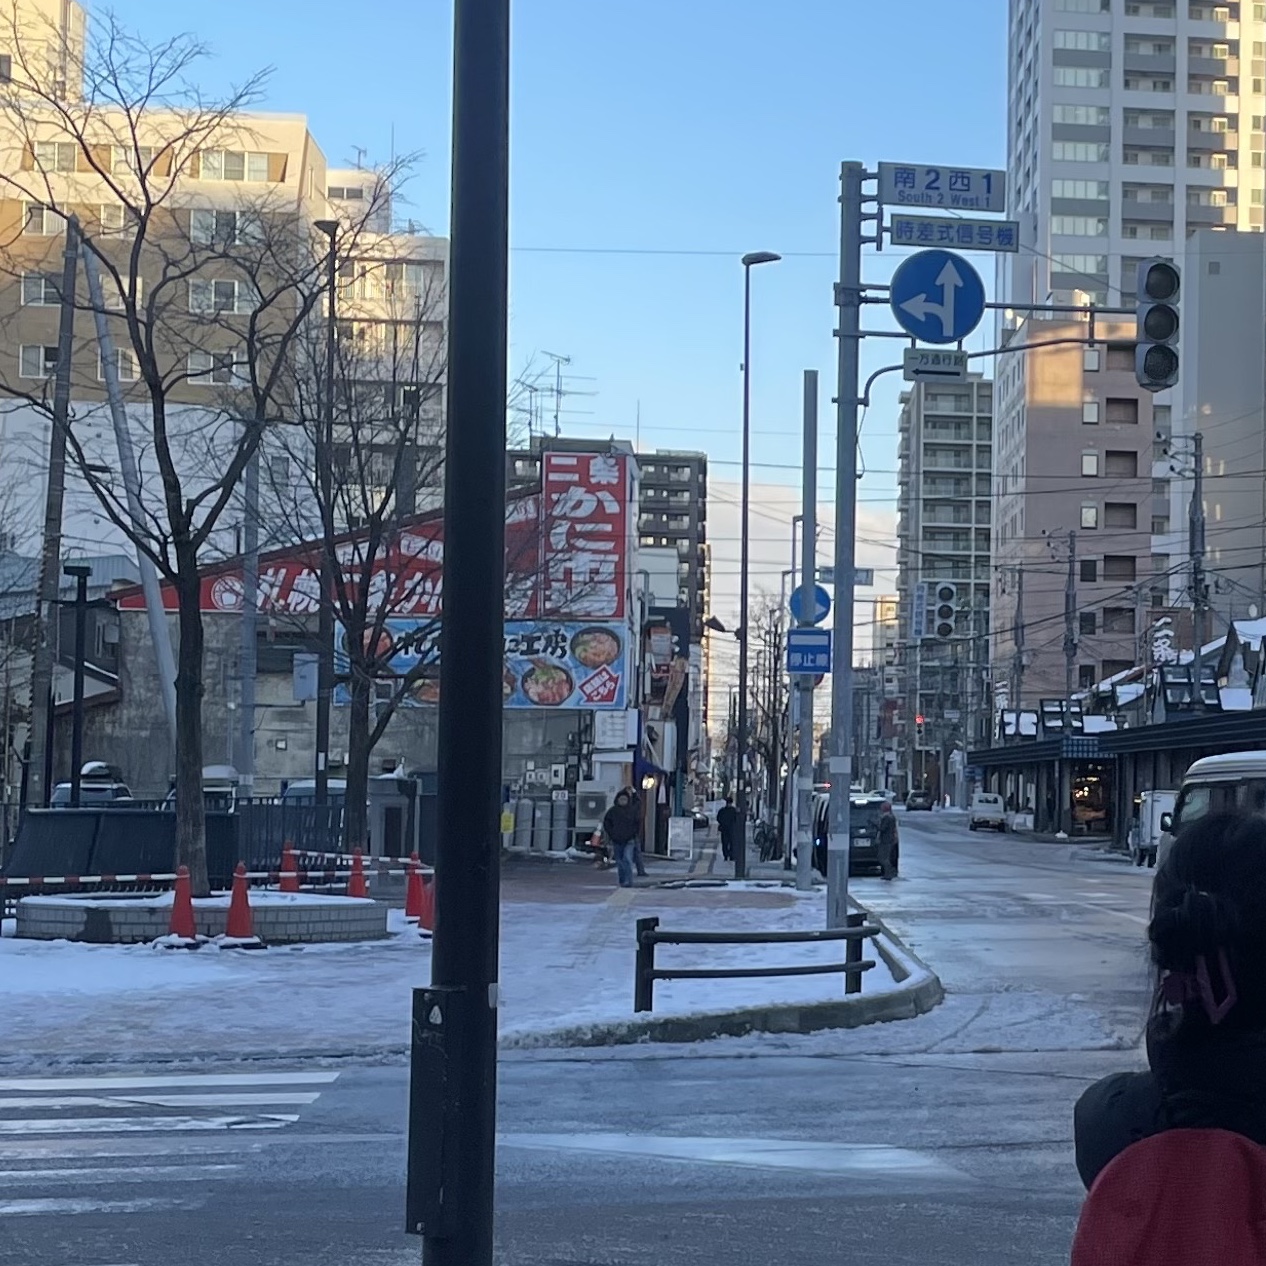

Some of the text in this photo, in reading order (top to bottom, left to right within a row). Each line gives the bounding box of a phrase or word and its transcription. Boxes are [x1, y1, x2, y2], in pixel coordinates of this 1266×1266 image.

[898, 190, 932, 201] South
[937, 196, 945, 205] 2
[951, 194, 979, 206] West
[896, 220, 1014, 246] 時差式信号機
